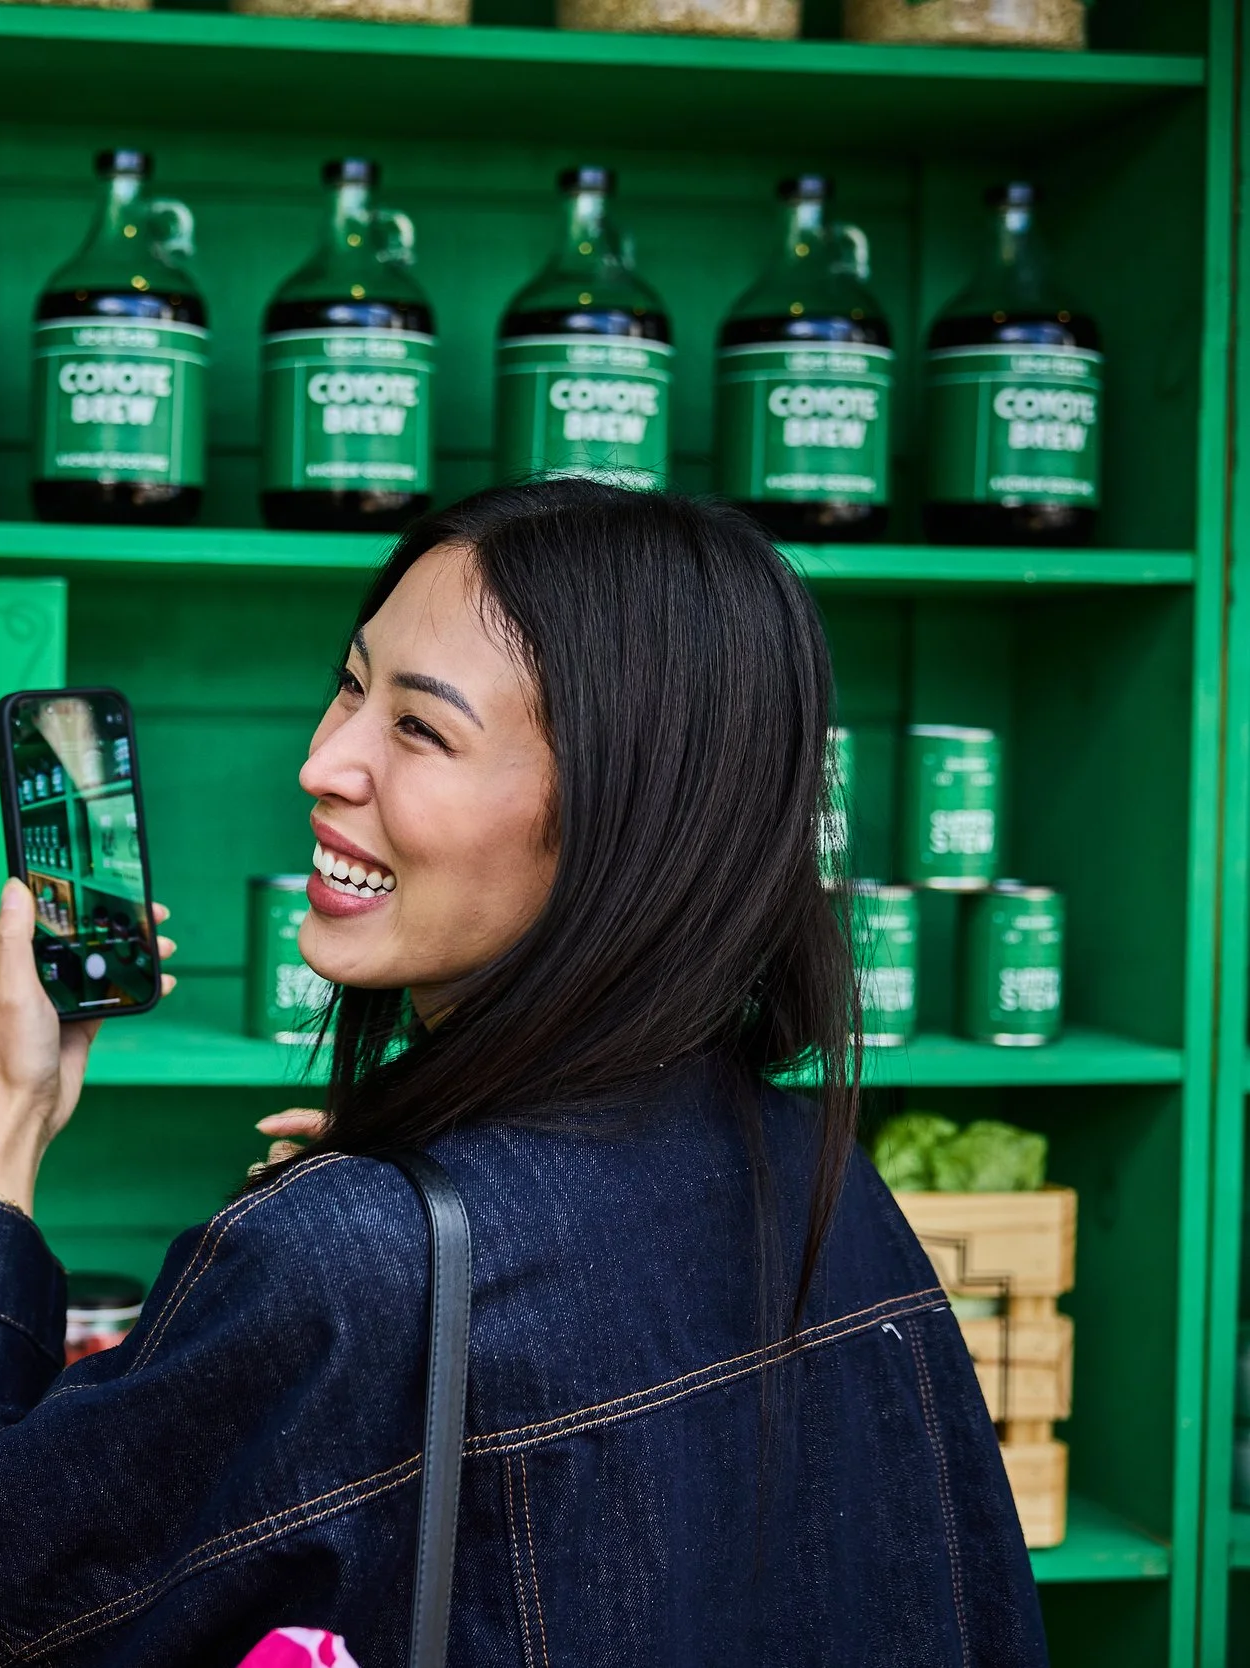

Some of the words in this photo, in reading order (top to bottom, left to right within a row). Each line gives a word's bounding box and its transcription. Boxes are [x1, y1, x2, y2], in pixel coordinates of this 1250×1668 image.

[58, 361, 173, 398] COYOTE
[307, 370, 419, 408] COYOTE
[70, 394, 159, 426] BREW
[768, 385, 878, 422] COYOTE
[993, 386, 1098, 425] COYOTE
